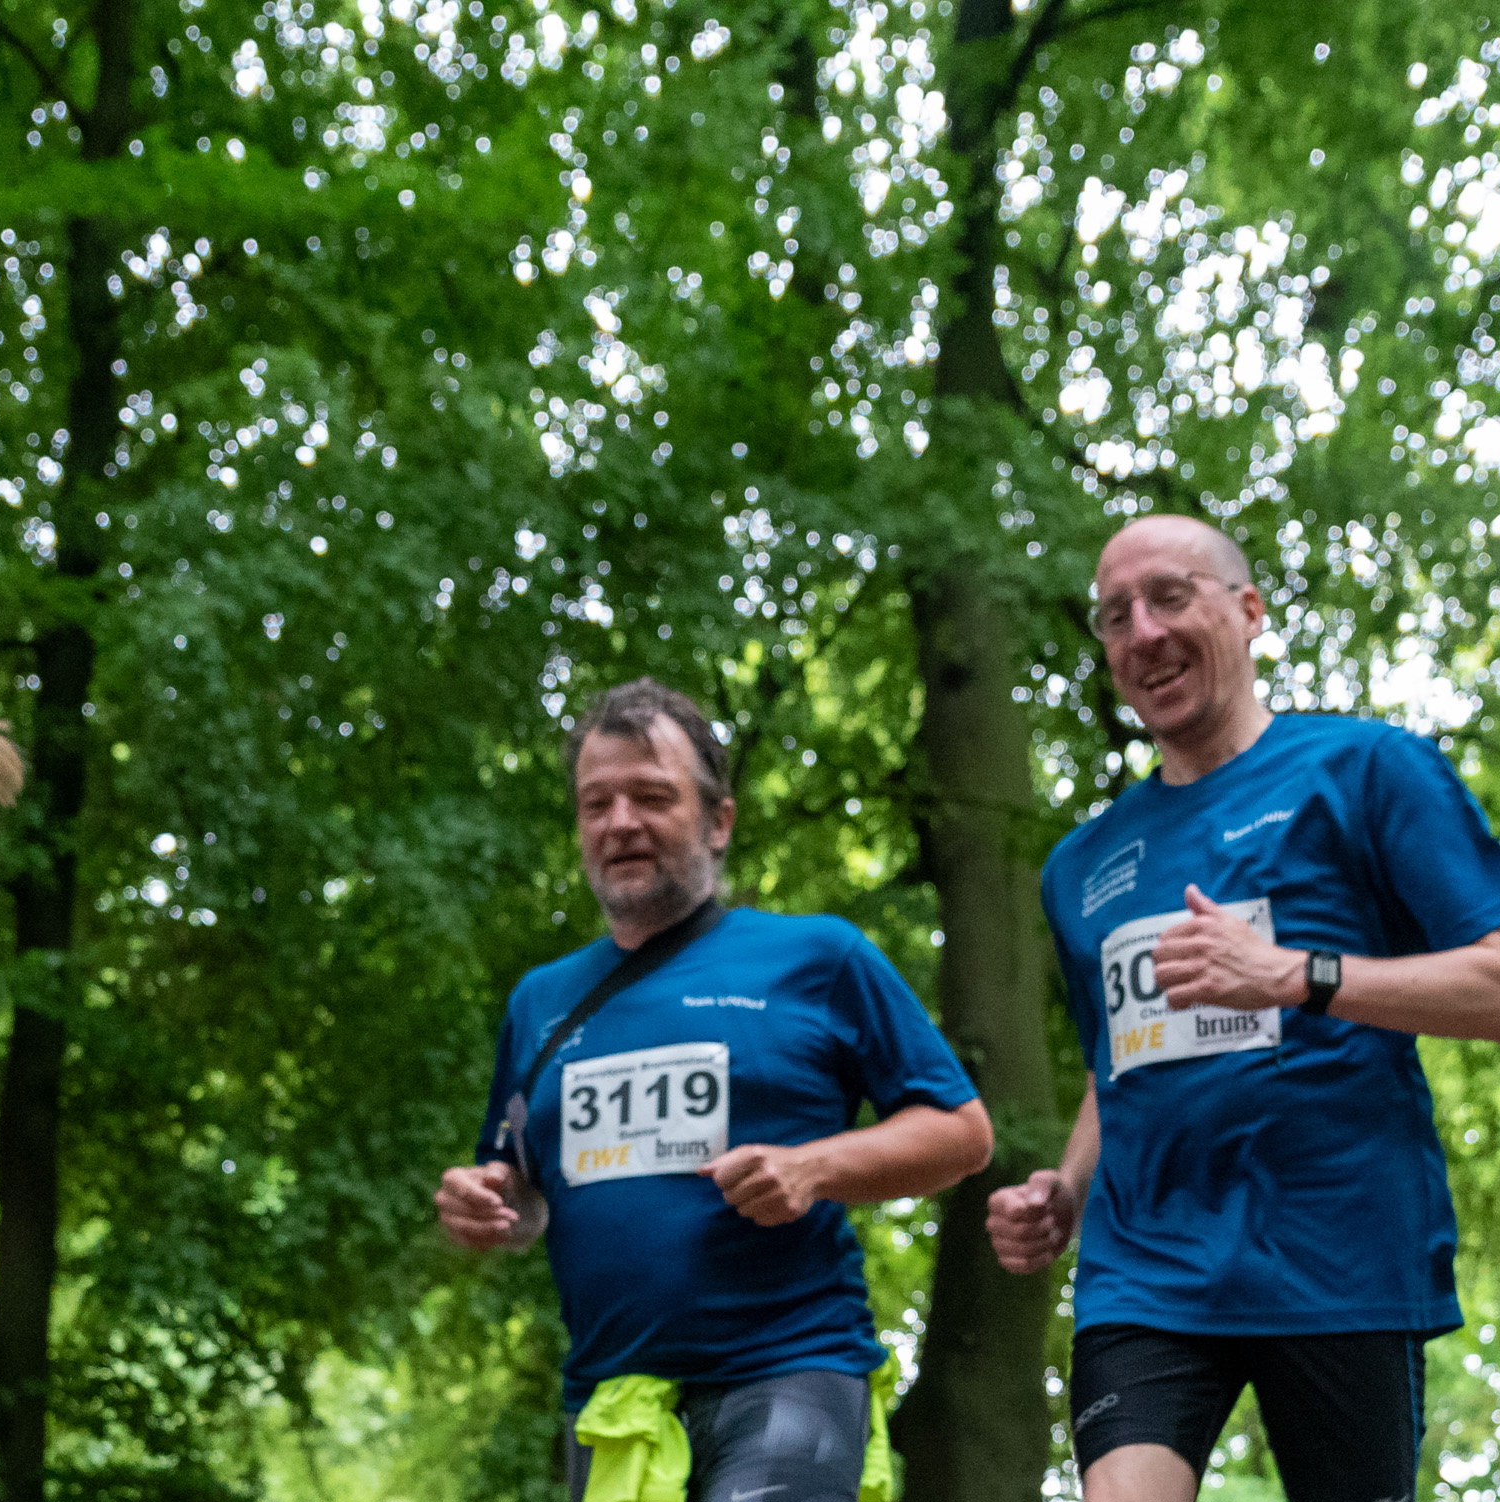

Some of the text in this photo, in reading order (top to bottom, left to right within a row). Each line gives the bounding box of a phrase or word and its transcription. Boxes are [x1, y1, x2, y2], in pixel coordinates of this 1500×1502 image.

[1195, 1013, 1259, 1038] bruns
[568, 1070, 720, 1132] 3119
[576, 1143, 632, 1172] EWE
[655, 1138, 710, 1159] bruns
